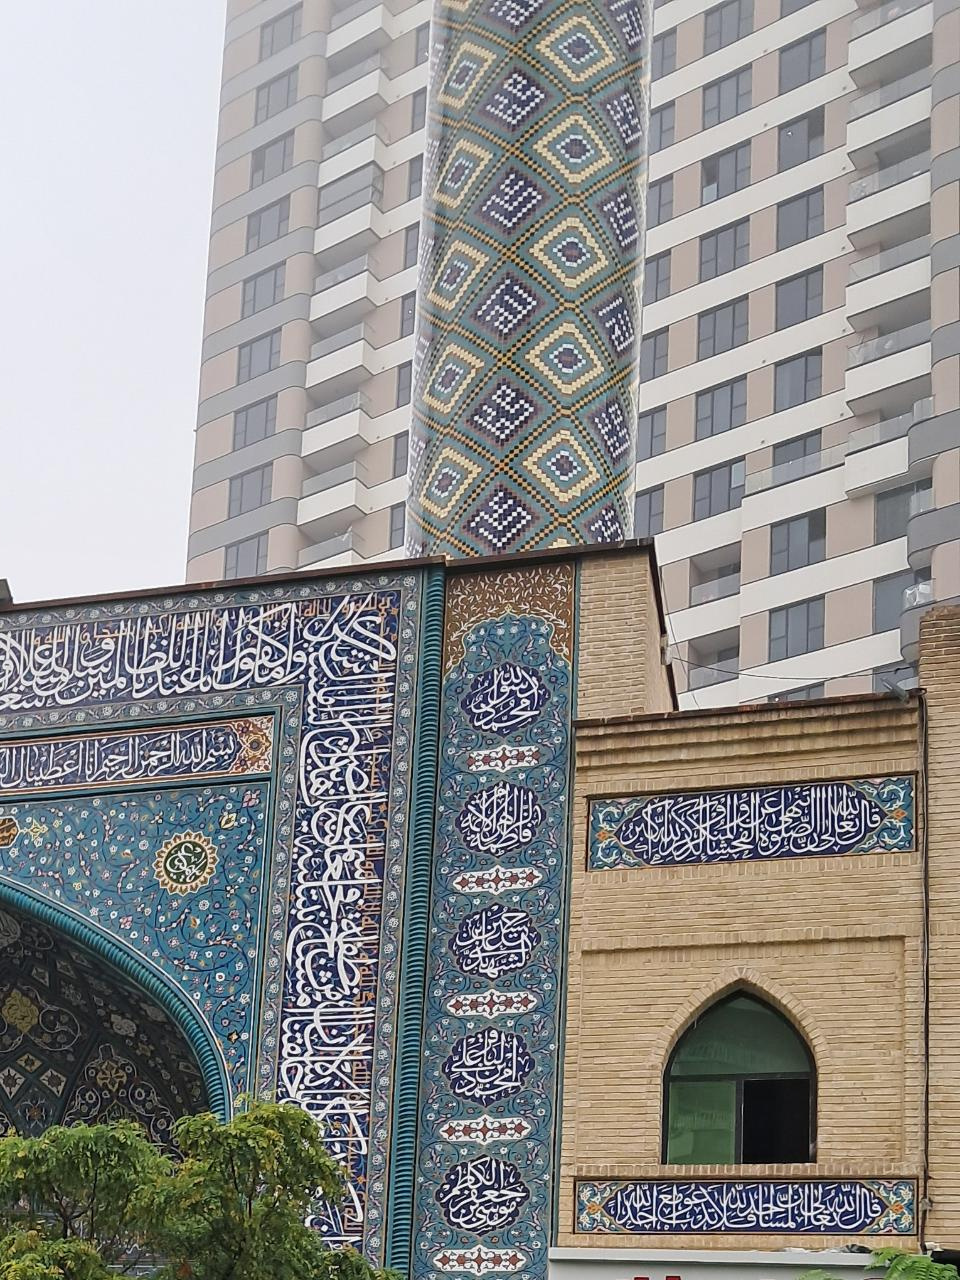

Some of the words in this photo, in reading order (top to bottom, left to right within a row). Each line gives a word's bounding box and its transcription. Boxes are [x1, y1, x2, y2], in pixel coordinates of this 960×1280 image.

[95, 735, 137, 781] الرحيم
[128, 732, 180, 779] الرحمن
[178, 730, 207, 772] الله
[198, 731, 234, 770] بسم
